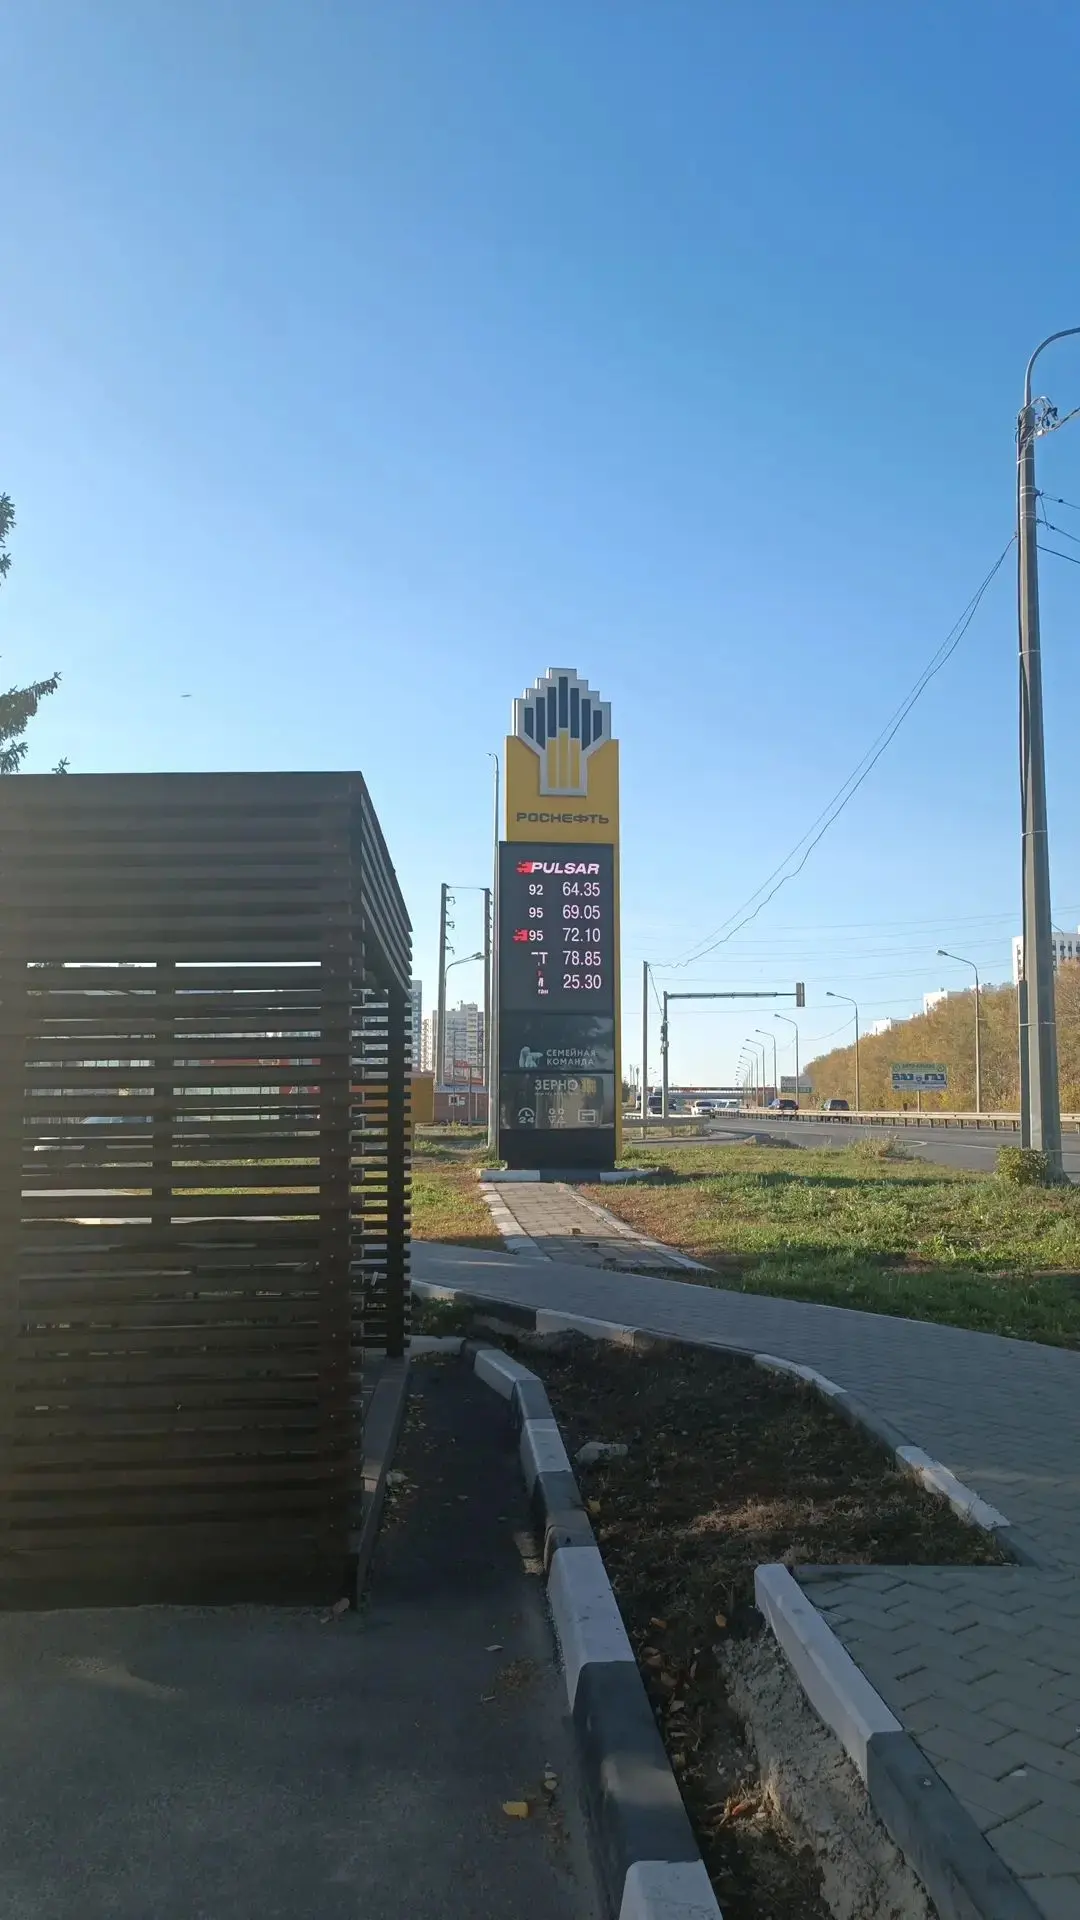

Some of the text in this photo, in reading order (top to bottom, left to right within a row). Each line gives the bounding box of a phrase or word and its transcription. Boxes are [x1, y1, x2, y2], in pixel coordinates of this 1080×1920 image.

[516, 812, 609, 824] РОСНЕФТЬ
[531, 862, 600, 875] PULSAR
[528, 882, 600, 897] 92 64.35
[528, 904, 601, 920] 95 69.05
[528, 927, 601, 943] 95 72.10
[562, 950, 601, 966] 78.85
[563, 974, 602, 990] 25.30
[546, 1048, 597, 1057] СЕМЕЙНАЯ
[546, 1058, 594, 1066] КОМАНДА
[534, 1079, 579, 1091] ЗЕРНО
